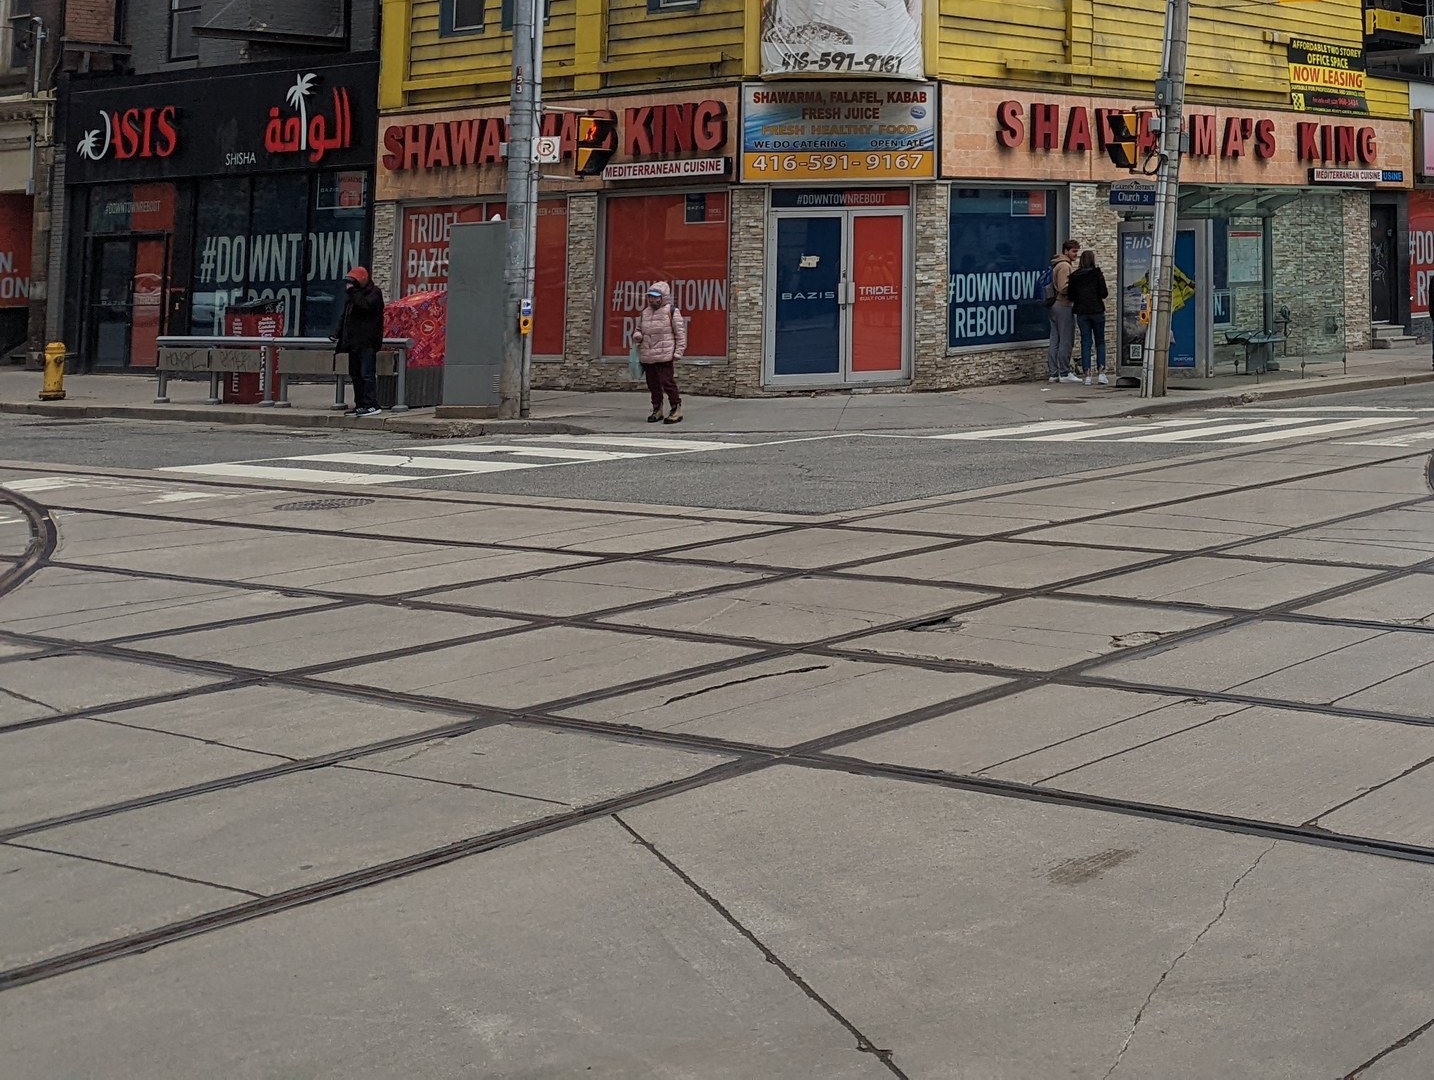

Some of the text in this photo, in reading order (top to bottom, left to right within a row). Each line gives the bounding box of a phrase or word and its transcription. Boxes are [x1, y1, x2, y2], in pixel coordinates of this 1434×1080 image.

[1292, 40, 1362, 58] AFFORDABLE TWO STOREY
[1306, 53, 1349, 69] OFFICE SPACE
[1293, 65, 1363, 88] NOW LEASING
[752, 91, 927, 105] SHAWARMA, FALAFEL, KABAB
[801, 107, 880, 120] FRESH JUICE
[624, 99, 728, 156] KING
[761, 124, 918, 136] FRESH HEALTHY FOOD
[753, 140, 847, 149] WE DO CATERING
[870, 139, 925, 148] OPEN LATE
[1296, 121, 1378, 164] KING
[224, 151, 257, 166] SHISHA
[604, 160, 721, 178] MEDITERRANEAN CUISINE
[1315, 170, 1381, 180] MEDITERRANEAN CUISINE
[796, 193, 886, 206] #DOWNTOWNREBOOT
[1117, 191, 1140, 202] Church
[103, 200, 161, 215] #DOWNTOWNREBOOT
[612, 278, 727, 312] #DOTOWN
[781, 291, 836, 301] BAZIS
[858, 285, 899, 295] TRIDEL
[955, 304, 1018, 339] REBOOT
